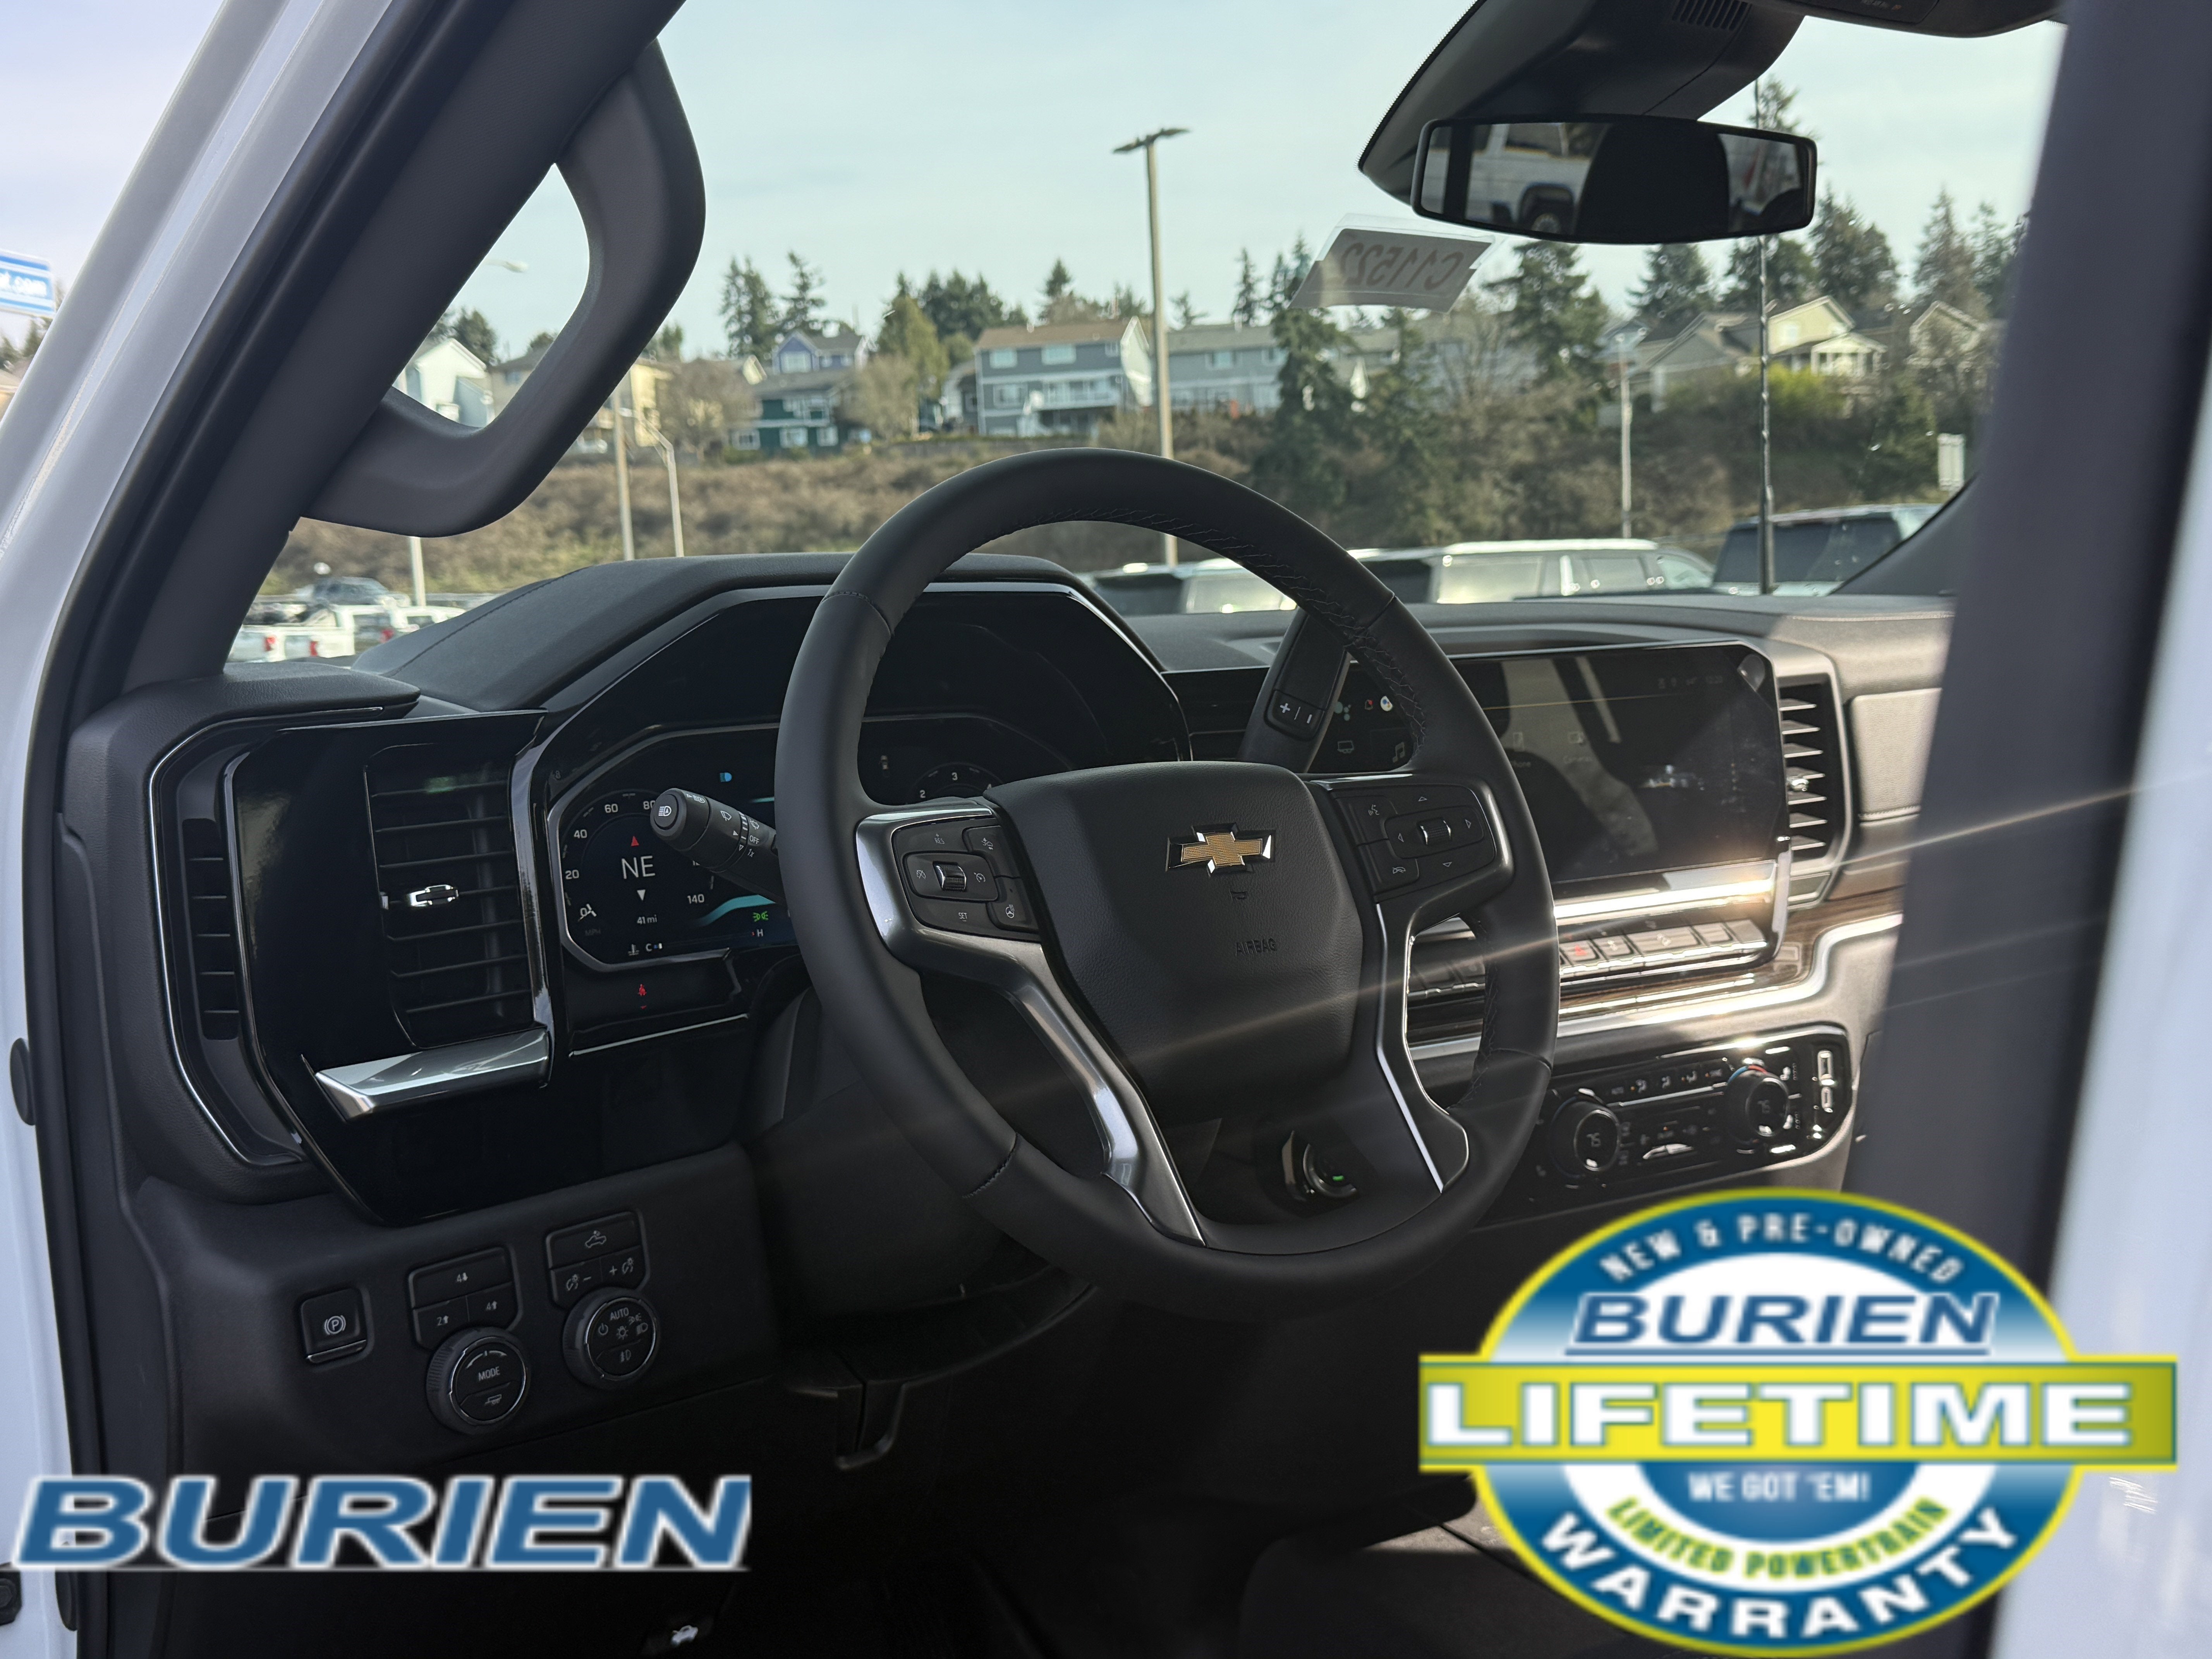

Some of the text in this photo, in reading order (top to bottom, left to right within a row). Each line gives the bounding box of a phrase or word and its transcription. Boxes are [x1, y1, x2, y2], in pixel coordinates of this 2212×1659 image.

[952, 772, 958, 781] 3
[920, 790, 926, 798] 2
[605, 804, 618, 813] 60
[574, 829, 587, 838] 40
[749, 835, 760, 844] OFF
[622, 855, 655, 879] NE
[565, 869, 579, 879] 20
[687, 894, 705, 904] 140
[637, 914, 658, 924] 41 mi
[646, 943, 652, 952] C
[1235, 938, 1277, 956] AIRBAG
[610, 1307, 629, 1321] AUTO
[478, 1366, 501, 1381] MODE
